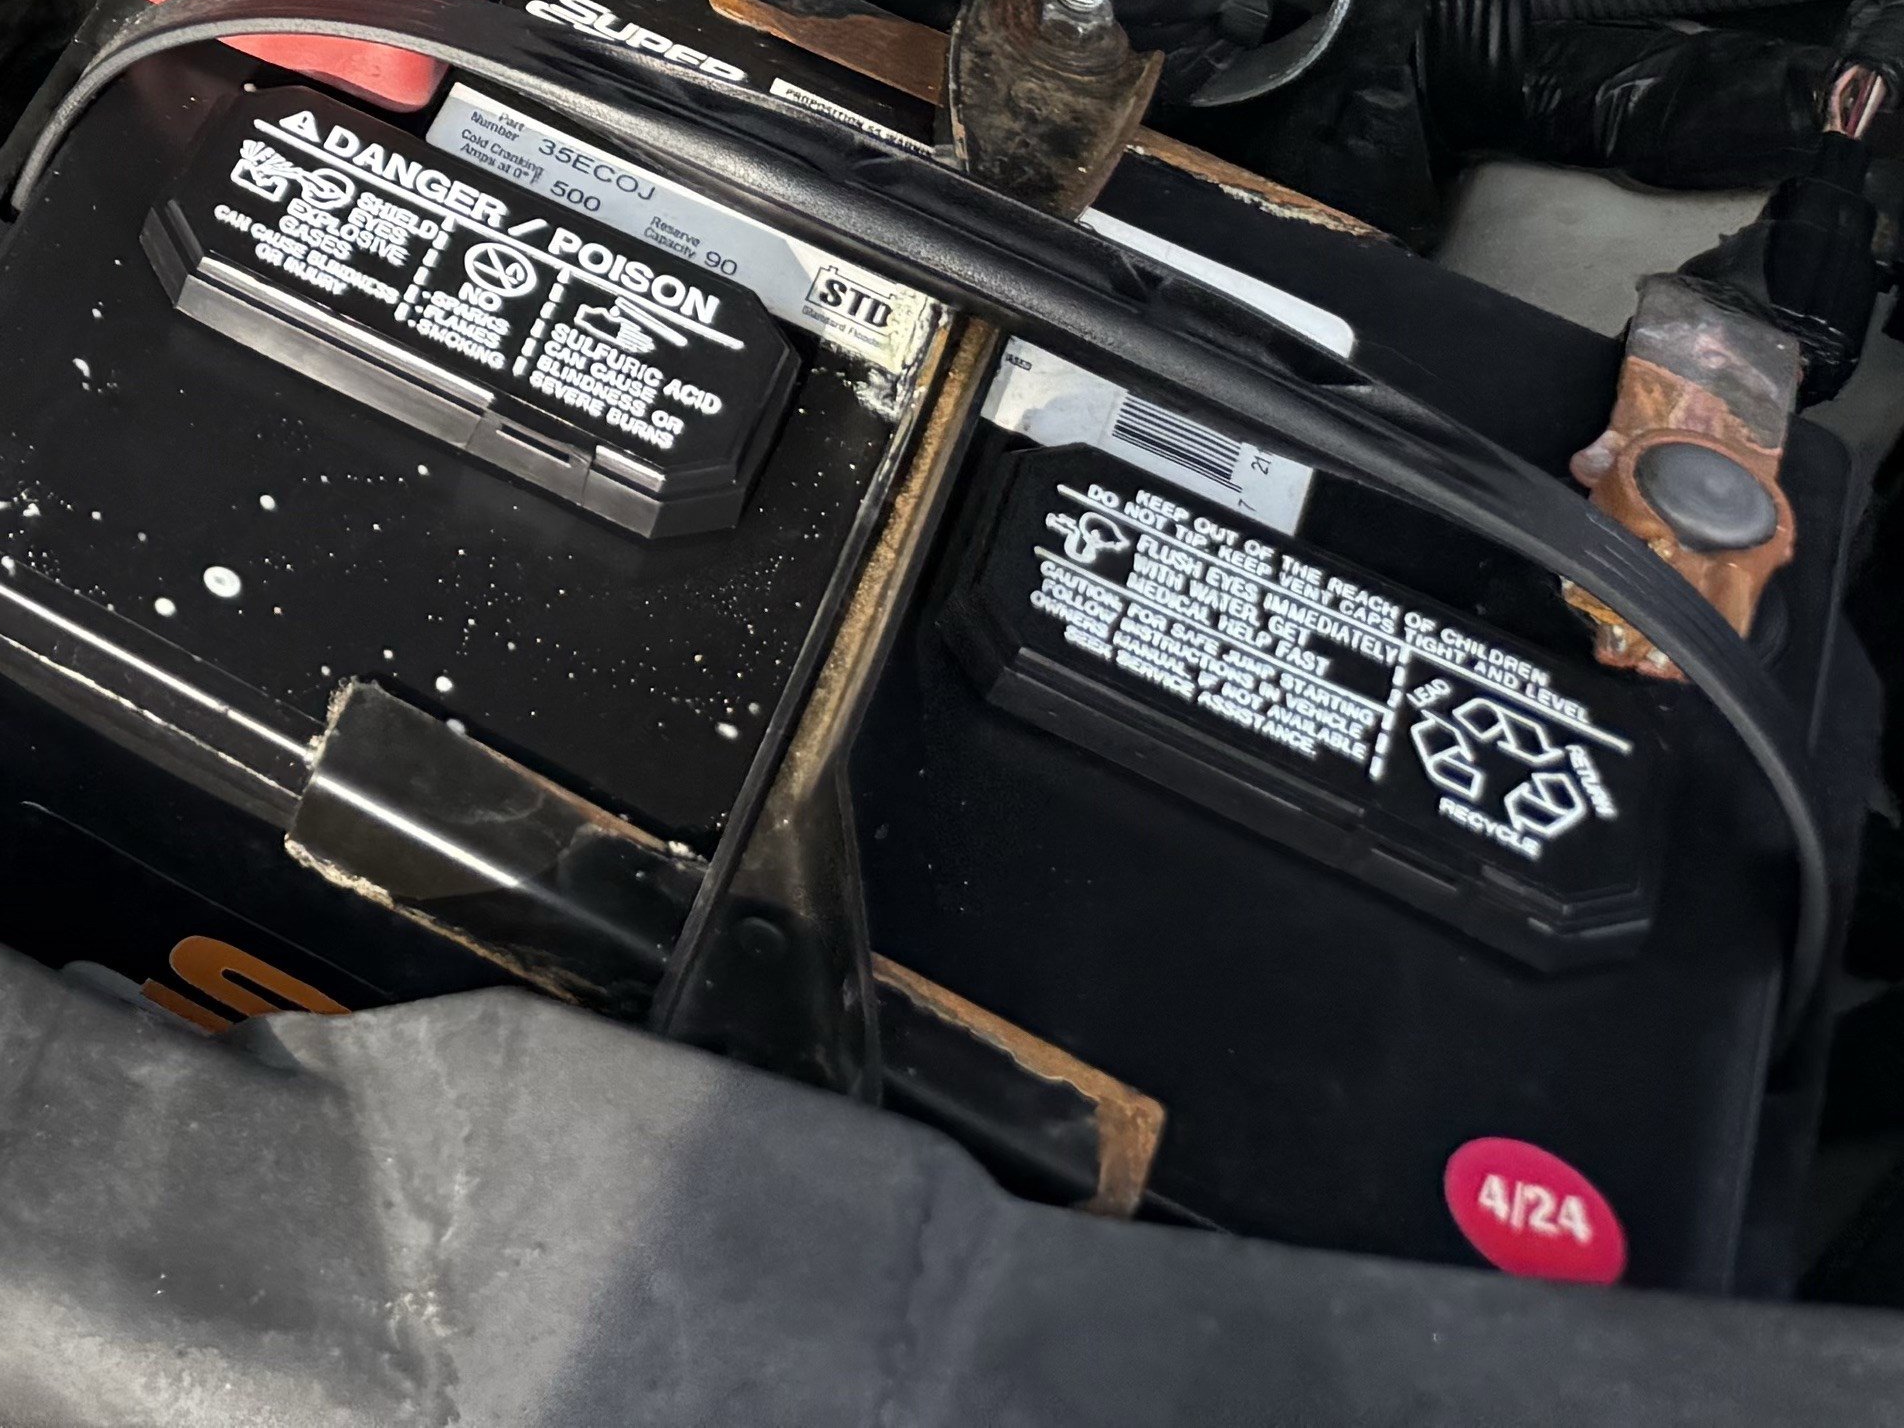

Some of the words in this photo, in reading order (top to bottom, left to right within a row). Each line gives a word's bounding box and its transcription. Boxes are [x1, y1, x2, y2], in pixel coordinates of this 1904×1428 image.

[538, 139, 656, 201] 35ECOJ
[550, 180, 602, 212] 500
[214, 205, 253, 232] CAN
[251, 223, 309, 260] CAUSE
[279, 215, 353, 261] GASES
[287, 198, 410, 267] EXPLOSIVE
[323, 125, 508, 228] DANGER
[548, 227, 721, 325] POISON
[348, 207, 414, 250] EYES
[357, 192, 443, 244] SHIELD
[255, 243, 285, 267] OR
[704, 251, 738, 276] 90
[429, 291, 511, 339] SPARKS
[458, 282, 503, 312] NO
[818, 279, 894, 328] STD
[416, 318, 506, 370] SMOKING
[423, 304, 501, 355] FLAMES
[529, 370, 606, 418] SEVERE
[537, 354, 647, 422] BLINDNESS
[651, 410, 685, 436] OR
[544, 341, 588, 370] CAN
[586, 362, 658, 405] CAUSE
[551, 323, 664, 392] SULFURIC
[663, 379, 723, 415] ACID
[1088, 484, 1120, 509] DO
[1124, 502, 1168, 531] NOT
[1218, 545, 1273, 577] KEEP
[1280, 572, 1334, 606] VENT
[1339, 600, 1395, 635] CAPS
[1404, 627, 1467, 668] TIGHT
[1474, 661, 1519, 690] AND
[1134, 553, 1185, 592] WITH
[1268, 616, 1311, 647] GET
[1136, 490, 1190, 523] KEEP
[1194, 517, 1239, 547] OUT
[1244, 540, 1275, 561] OF
[1282, 555, 1323, 586] THE
[1327, 577, 1400, 621] REACH
[1404, 612, 1436, 633] OF
[1441, 629, 1548, 687] CHILDREN
[1137, 534, 1203, 579] FLUSH
[1206, 567, 1259, 604] EYES
[1263, 593, 1402, 664] IMMEDIATELY
[1126, 572, 1211, 626] MEDICAL
[1218, 615, 1273, 649] HELP
[1275, 640, 1330, 677] FAST
[1042, 579, 1120, 625] FOLLOW
[1120, 617, 1255, 690] INSTRUCTIONS
[1259, 681, 1281, 703] IN
[1286, 693, 1364, 740] VEHICLE
[1127, 603, 1168, 632] FOR
[1171, 623, 1220, 657] SAFE
[1222, 650, 1276, 680] JUMP
[1280, 673, 1375, 727] STARTING
[1222, 682, 1264, 711] NOT
[1267, 705, 1367, 760] AVAILABLE
[1406, 678, 1452, 708] LEAD
[1439, 796, 1542, 860] RECYCLE
[1476, 1173, 1593, 1245] 4/24
